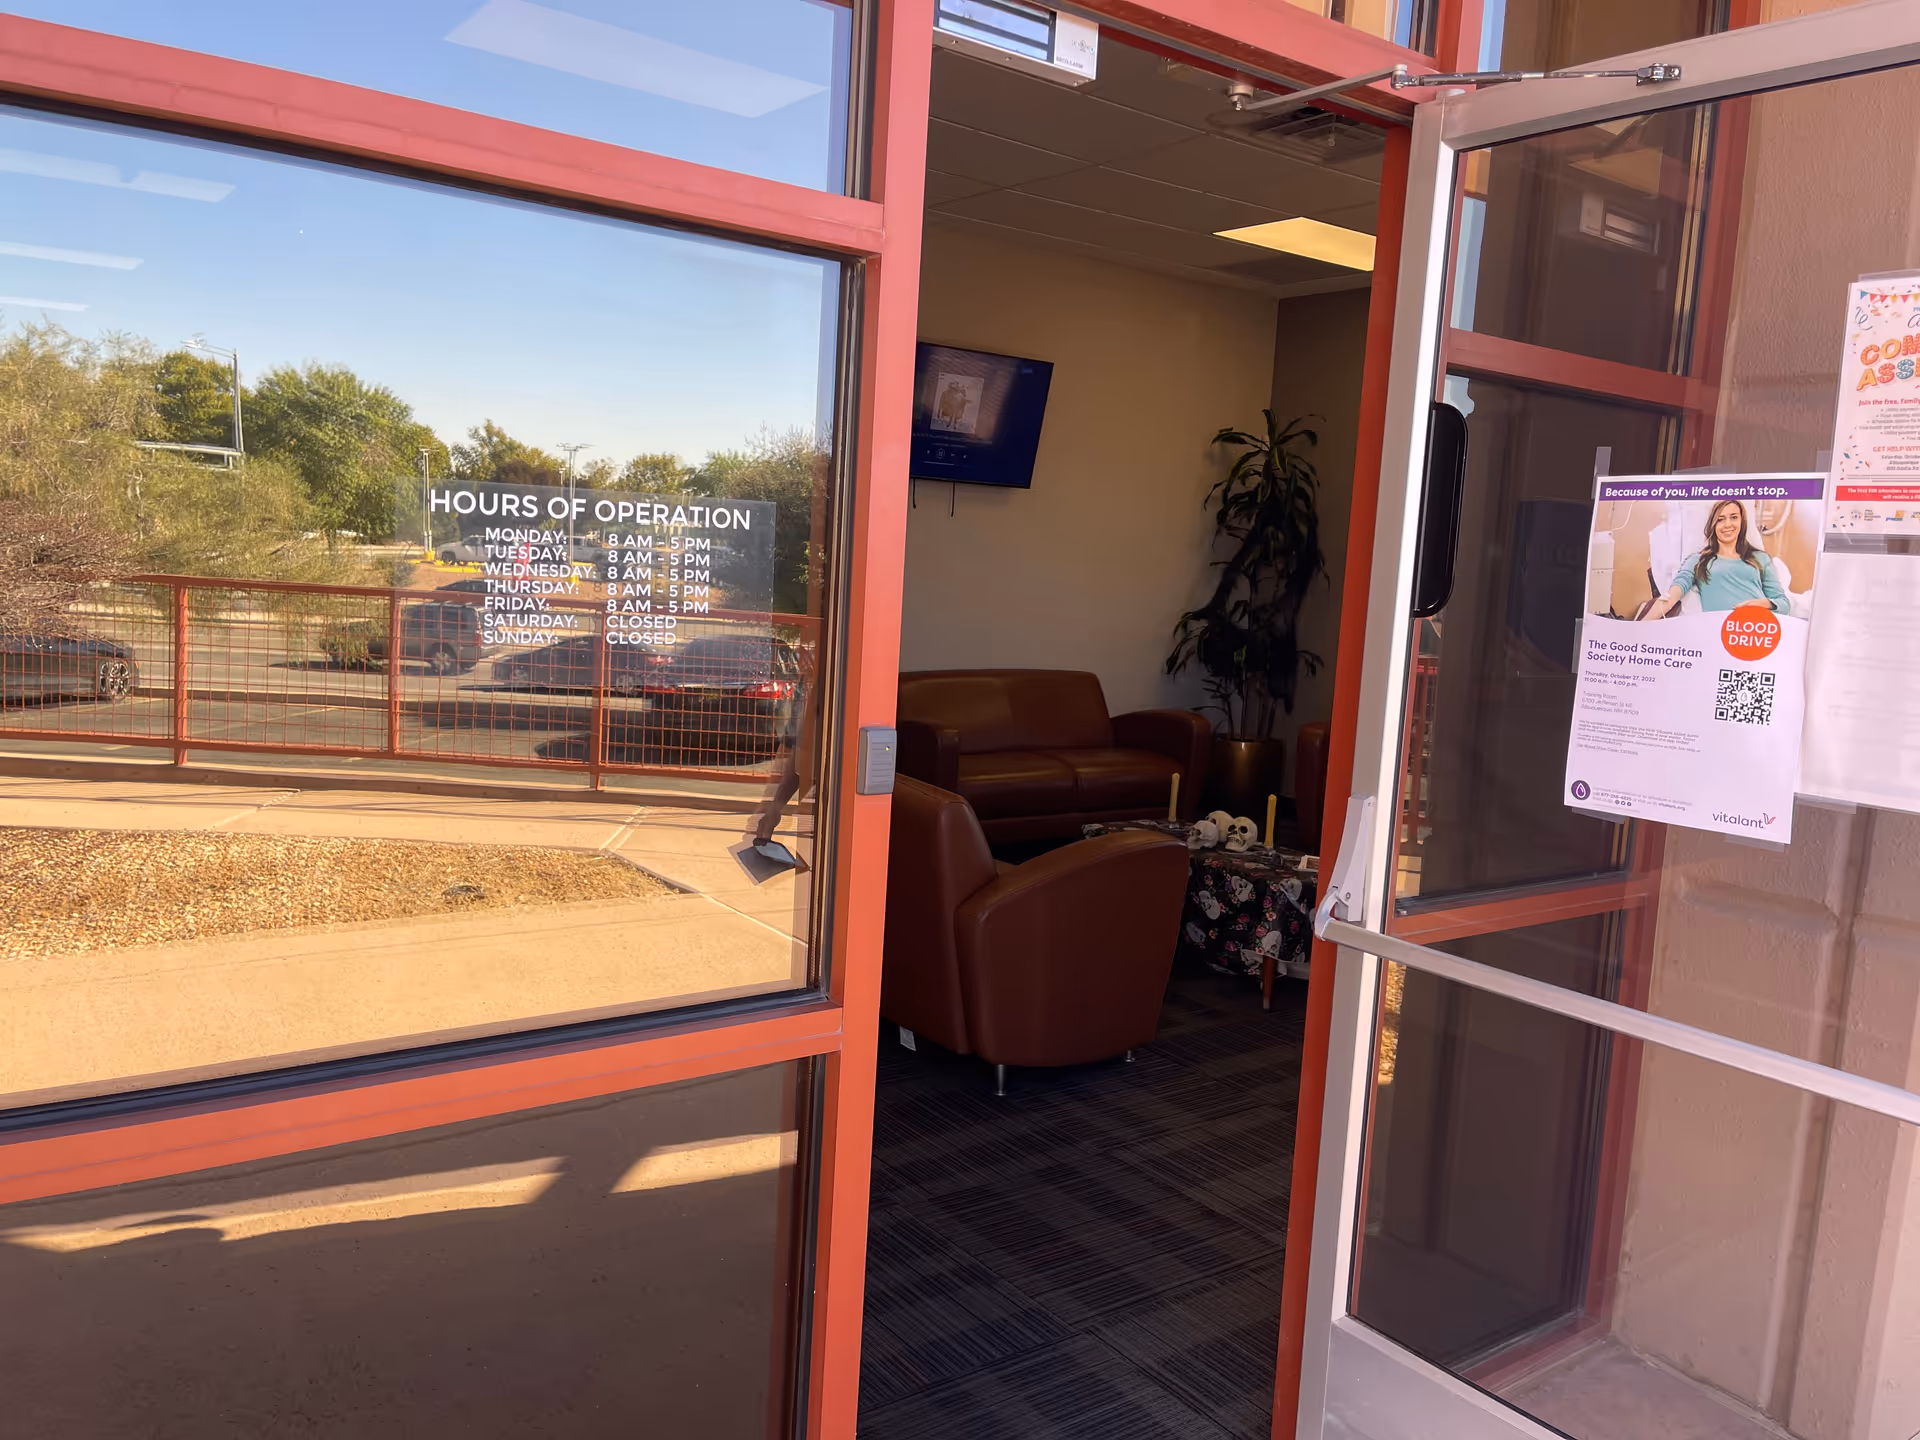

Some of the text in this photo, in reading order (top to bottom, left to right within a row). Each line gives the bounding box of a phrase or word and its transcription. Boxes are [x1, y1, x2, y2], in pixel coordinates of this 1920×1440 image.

[1606, 486, 1788, 498] Because of you, life doesn't stop.
[430, 489, 750, 530] HOURS OF OPERATION
[485, 527, 568, 545] MONDAY:
[608, 534, 617, 546] 8
[623, 535, 652, 548] AM
[671, 537, 679, 549] 5
[685, 538, 711, 550] PM
[485, 545, 567, 562] TUESDAY:
[608, 551, 617, 563] 8
[623, 551, 652, 565] AM
[670, 553, 679, 565] 5
[685, 554, 710, 567] PM
[485, 562, 597, 579] WEDNESDAY:
[608, 567, 617, 579] 8
[623, 568, 652, 581] AM
[670, 570, 678, 582] 5
[684, 570, 710, 582] PM
[484, 580, 579, 595] THURSDAY:
[608, 583, 617, 596] 8
[622, 584, 651, 597] AM
[670, 586, 678, 598] 5
[684, 586, 709, 598] PM
[484, 597, 549, 610] FRIDAY:
[607, 600, 617, 612] 8
[622, 600, 651, 613] AM
[669, 602, 678, 613] 5
[683, 602, 709, 614] PM
[483, 614, 677, 629] SATURDAY: CLOSED
[1726, 621, 1778, 634] BLOOD
[483, 631, 677, 645] SUNDAY: CLOSED
[1728, 634, 1772, 648] DRIVE
[1589, 640, 1702, 658] The Good Samaritan
[1587, 651, 1692, 669] Society Home Care
[1712, 812, 1764, 828] vitalant
